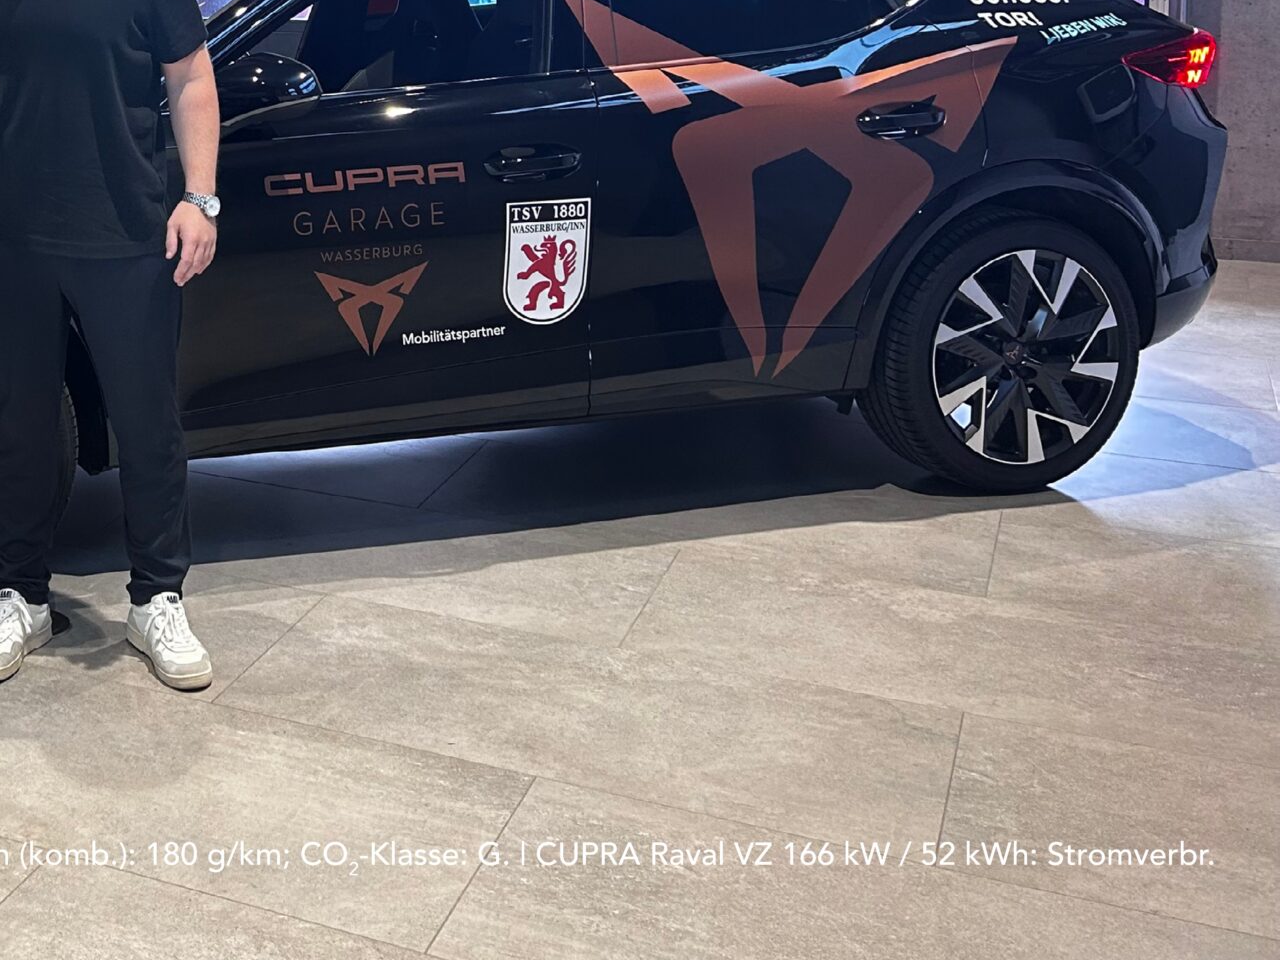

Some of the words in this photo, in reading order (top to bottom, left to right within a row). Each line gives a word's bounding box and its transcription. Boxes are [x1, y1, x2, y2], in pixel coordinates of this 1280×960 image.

[976, 11, 1045, 29] TOR!
[1039, 18, 1093, 46] LIEBEN
[263, 161, 467, 197] CUPRA
[292, 201, 446, 237] GARAGE
[510, 205, 543, 222] TSV
[552, 203, 586, 219] 1880
[511, 220, 587, 234] WASSERBURG/INN
[320, 243, 424, 263] WASSERBURG
[401, 325, 507, 346] Mobilitätspartner
